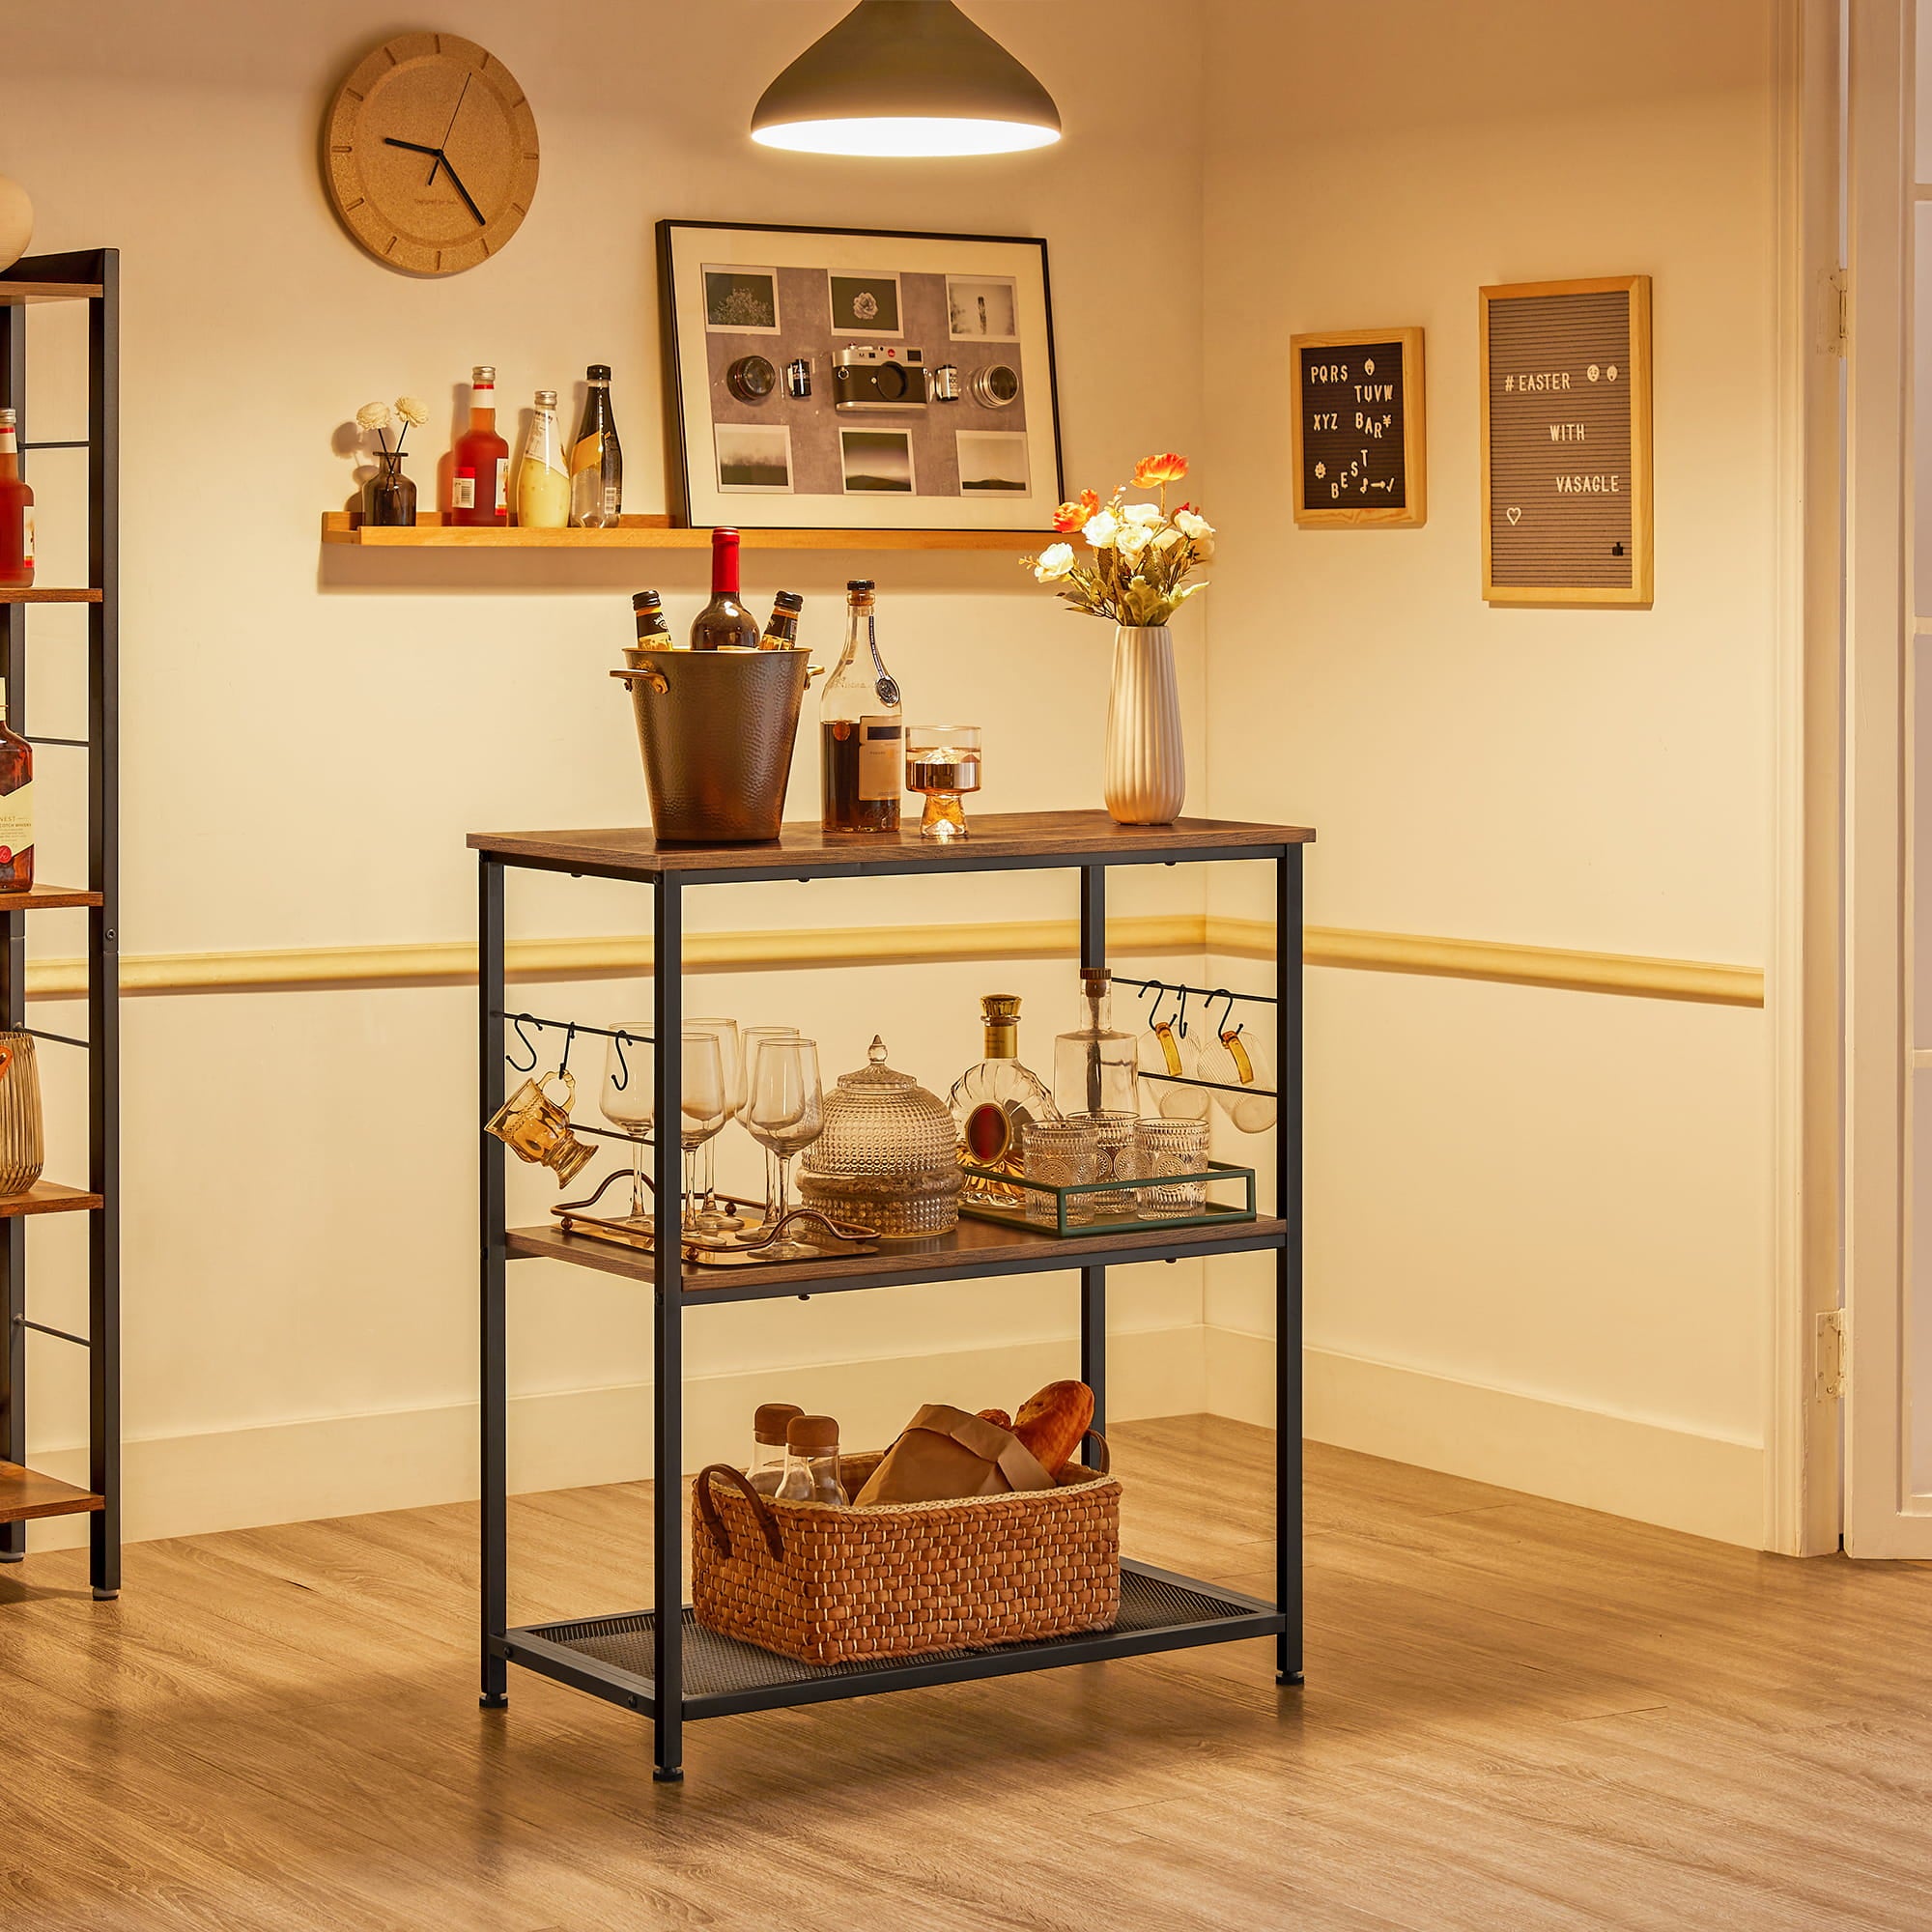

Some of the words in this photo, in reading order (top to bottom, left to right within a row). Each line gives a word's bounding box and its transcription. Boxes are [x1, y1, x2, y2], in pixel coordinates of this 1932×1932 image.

[1311, 365, 1349, 384] PQRS
[1354, 384, 1394, 403] TUVW
[1313, 413, 1338, 431] XYZ
[1549, 424, 1585, 441] WITH
[1330, 449, 1369, 498] BEST
[1556, 475, 1620, 493] VASAGLE
